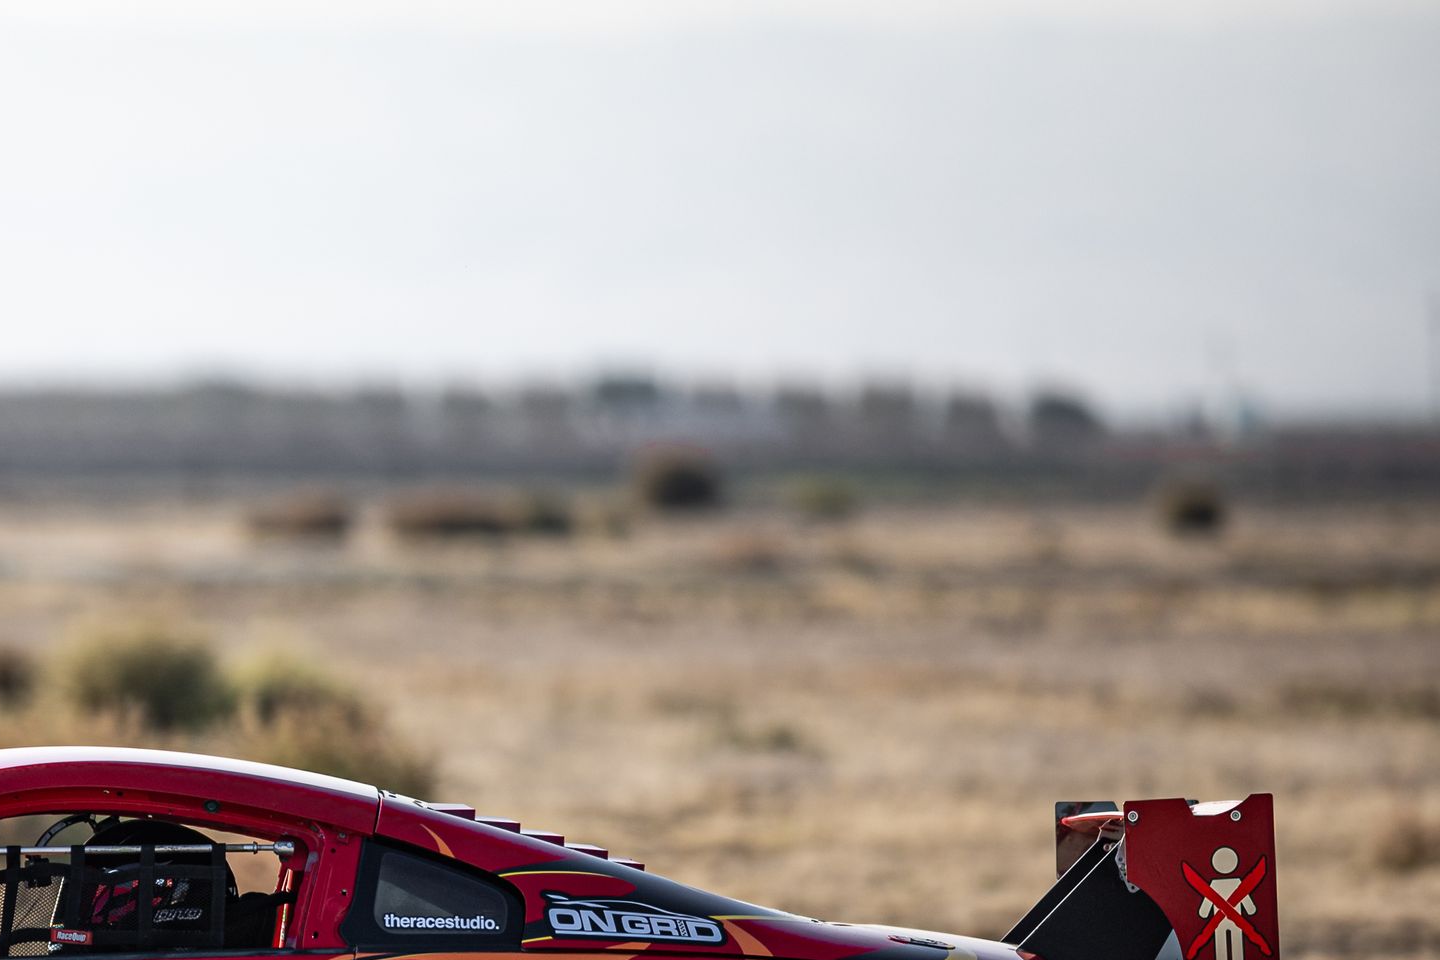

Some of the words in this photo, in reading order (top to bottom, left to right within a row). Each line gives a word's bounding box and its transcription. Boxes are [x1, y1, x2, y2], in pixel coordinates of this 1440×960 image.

[384, 913, 500, 930] theracestudio.
[549, 908, 616, 933] ON
[622, 914, 723, 943] GRID
